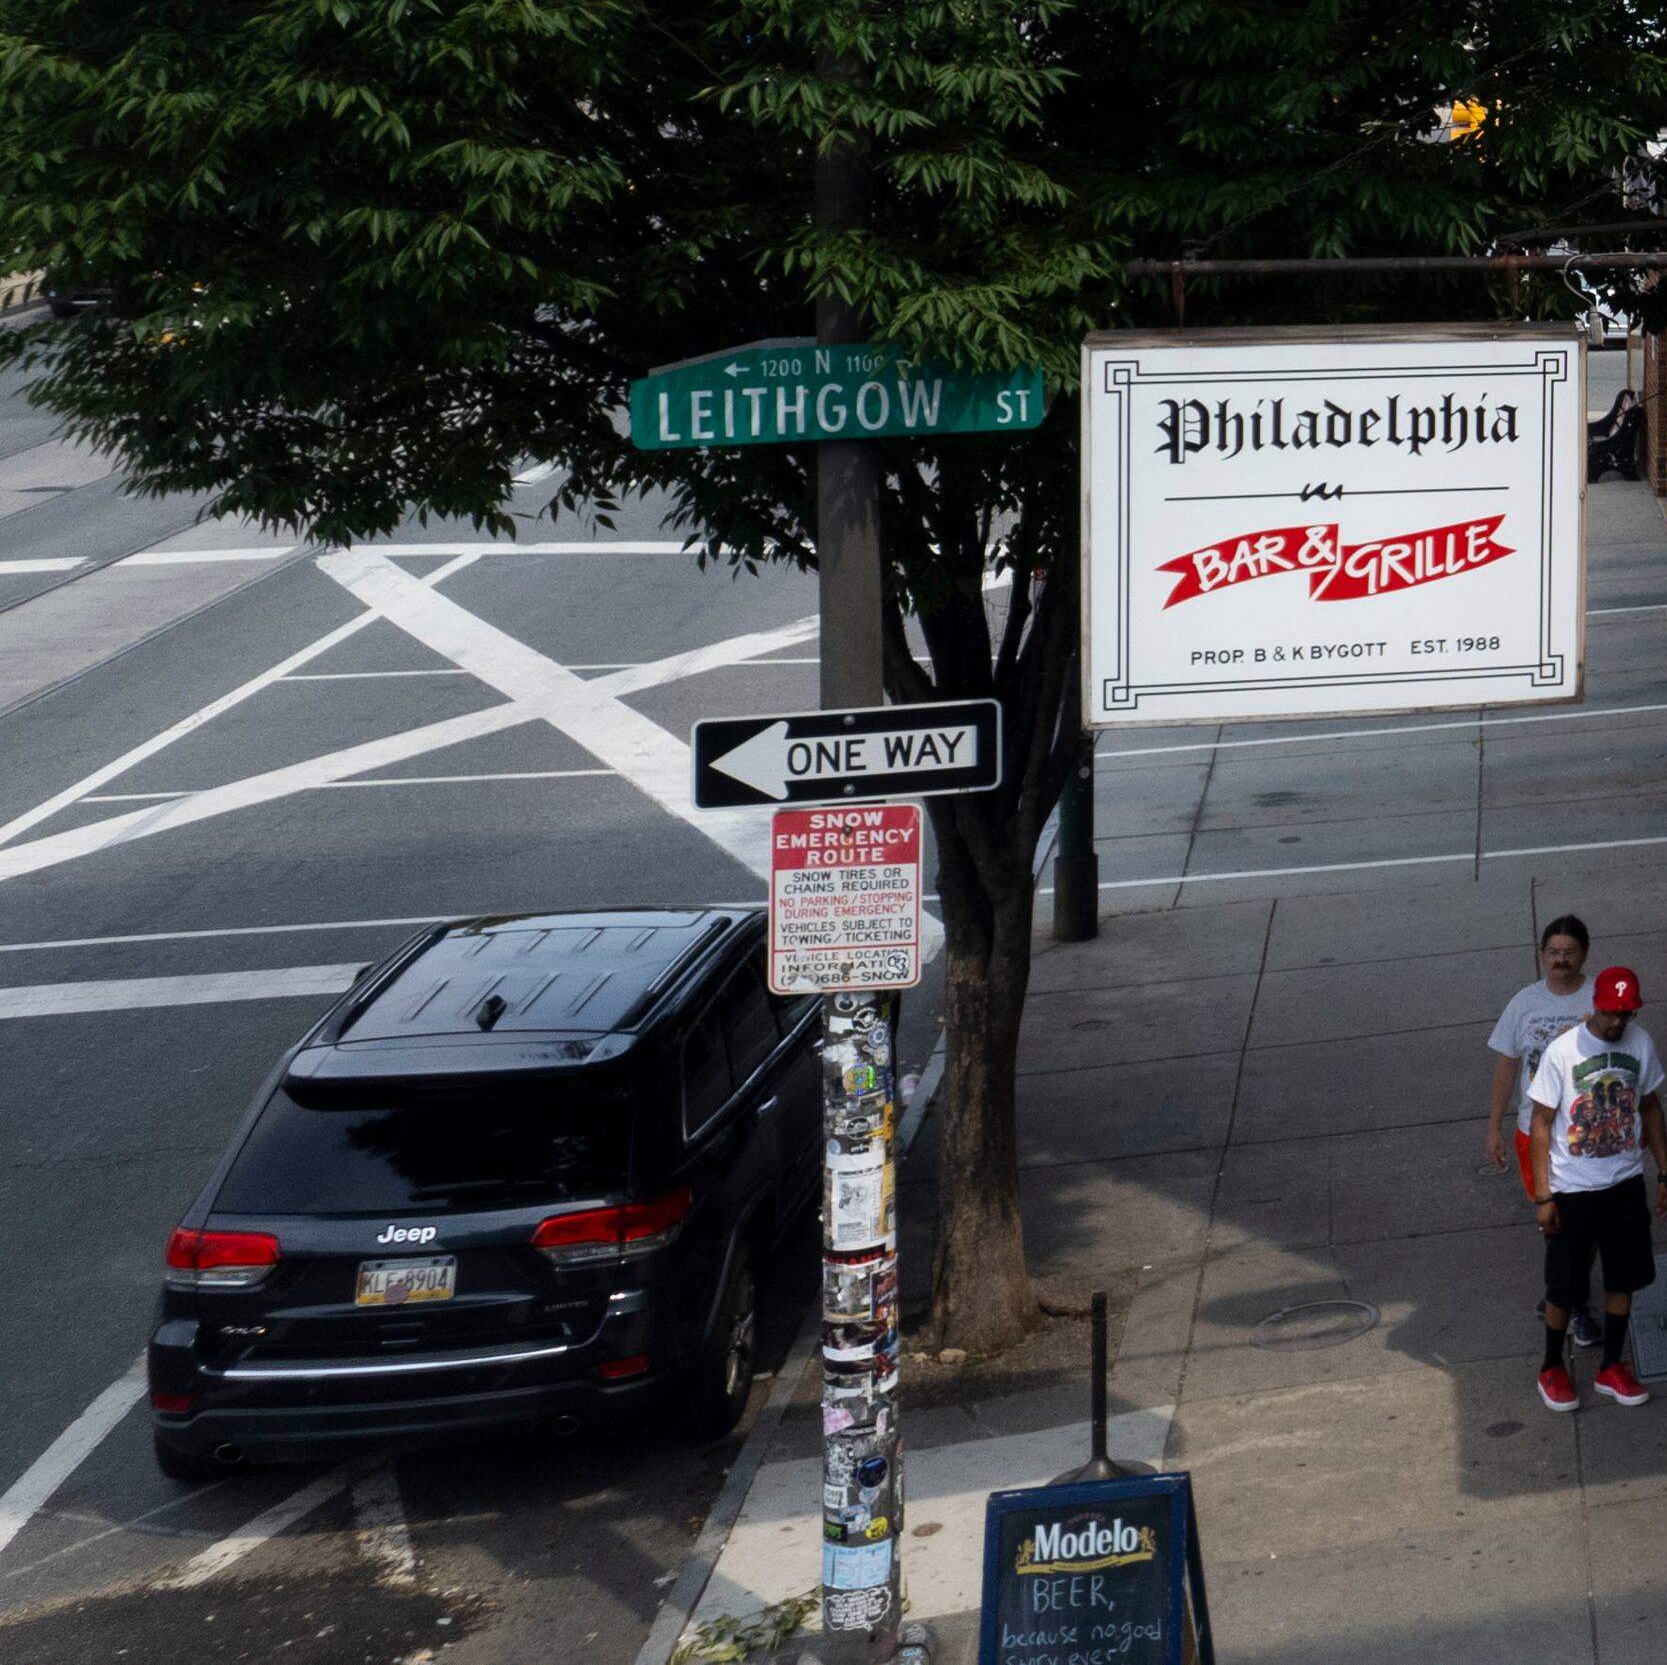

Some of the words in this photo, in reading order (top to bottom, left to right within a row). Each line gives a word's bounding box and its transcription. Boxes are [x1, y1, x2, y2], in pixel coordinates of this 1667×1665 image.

[761, 357, 801, 377] 1200
[815, 350, 831, 374] N
[658, 378, 942, 442] LEITHGOW
[996, 390, 1031, 424] ST
[1154, 392, 1520, 464] Philadelphia
[1192, 535, 1295, 592] BAR
[1298, 525, 1337, 566] &
[1345, 524, 1490, 595] GRILLE
[1191, 649, 1244, 665] PROP.
[1255, 648, 1267, 663] B
[1273, 647, 1286, 662] &
[1293, 646, 1304, 660] K
[1311, 642, 1387, 660] BYGOTT
[1411, 639, 1449, 655] EST.
[1456, 636, 1501, 653] 1988
[787, 738, 867, 776] ONE
[884, 730, 966, 769] WAY
[809, 811, 883, 829] SNOW
[776, 828, 914, 850] EMERGENCY
[807, 847, 885, 865] ROUTE
[792, 871, 832, 883] SNOW
[839, 869, 877, 881] TIRES
[883, 867, 902, 879] OR
[784, 882, 835, 895] CHAINS
[842, 879, 909, 892] REQUIRED
[779, 898, 795, 908] NO
[800, 895, 848, 907] PARKING
[784, 907, 828, 920] DURING
[834, 903, 906, 917] EMERGENCY
[780, 921, 836, 934] VEHICLES
[842, 918, 892, 931] SUBJECT
[899, 917, 912, 928] TO
[1615, 981, 1628, 998] P
[377, 1225, 437, 1244] Jeep
[1034, 1518, 1140, 1563] Modelo
[1002, 1623, 1078, 1648] because
[1091, 1623, 1116, 1640] no
[1119, 1618, 1162, 1653] good
[1068, 1648, 1117, 1665] ever
